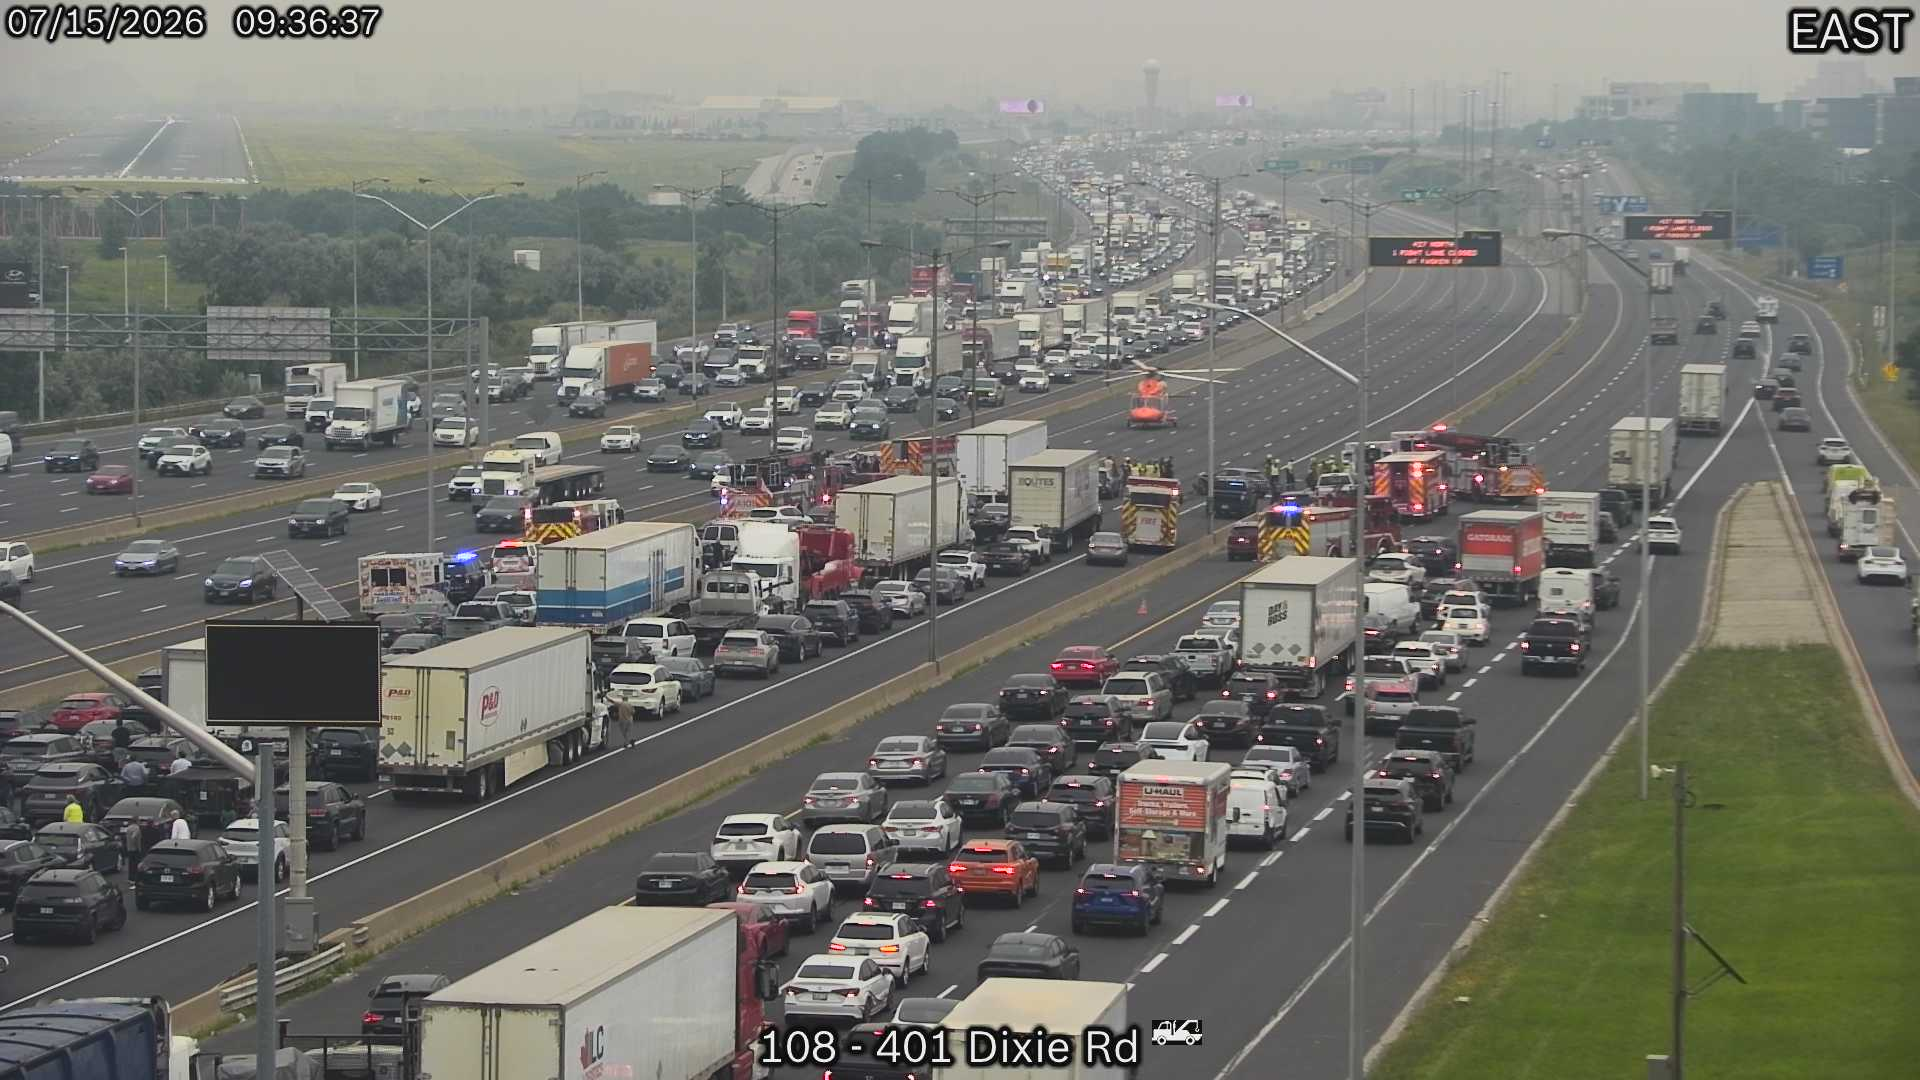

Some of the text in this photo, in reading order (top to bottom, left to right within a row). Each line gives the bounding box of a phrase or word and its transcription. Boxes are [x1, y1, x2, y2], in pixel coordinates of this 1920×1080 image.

[1553, 510, 1586, 521] Ryder
[1466, 533, 1513, 543] GATORADE
[388, 688, 412, 698] P&D
[480, 690, 500, 721] P&D
